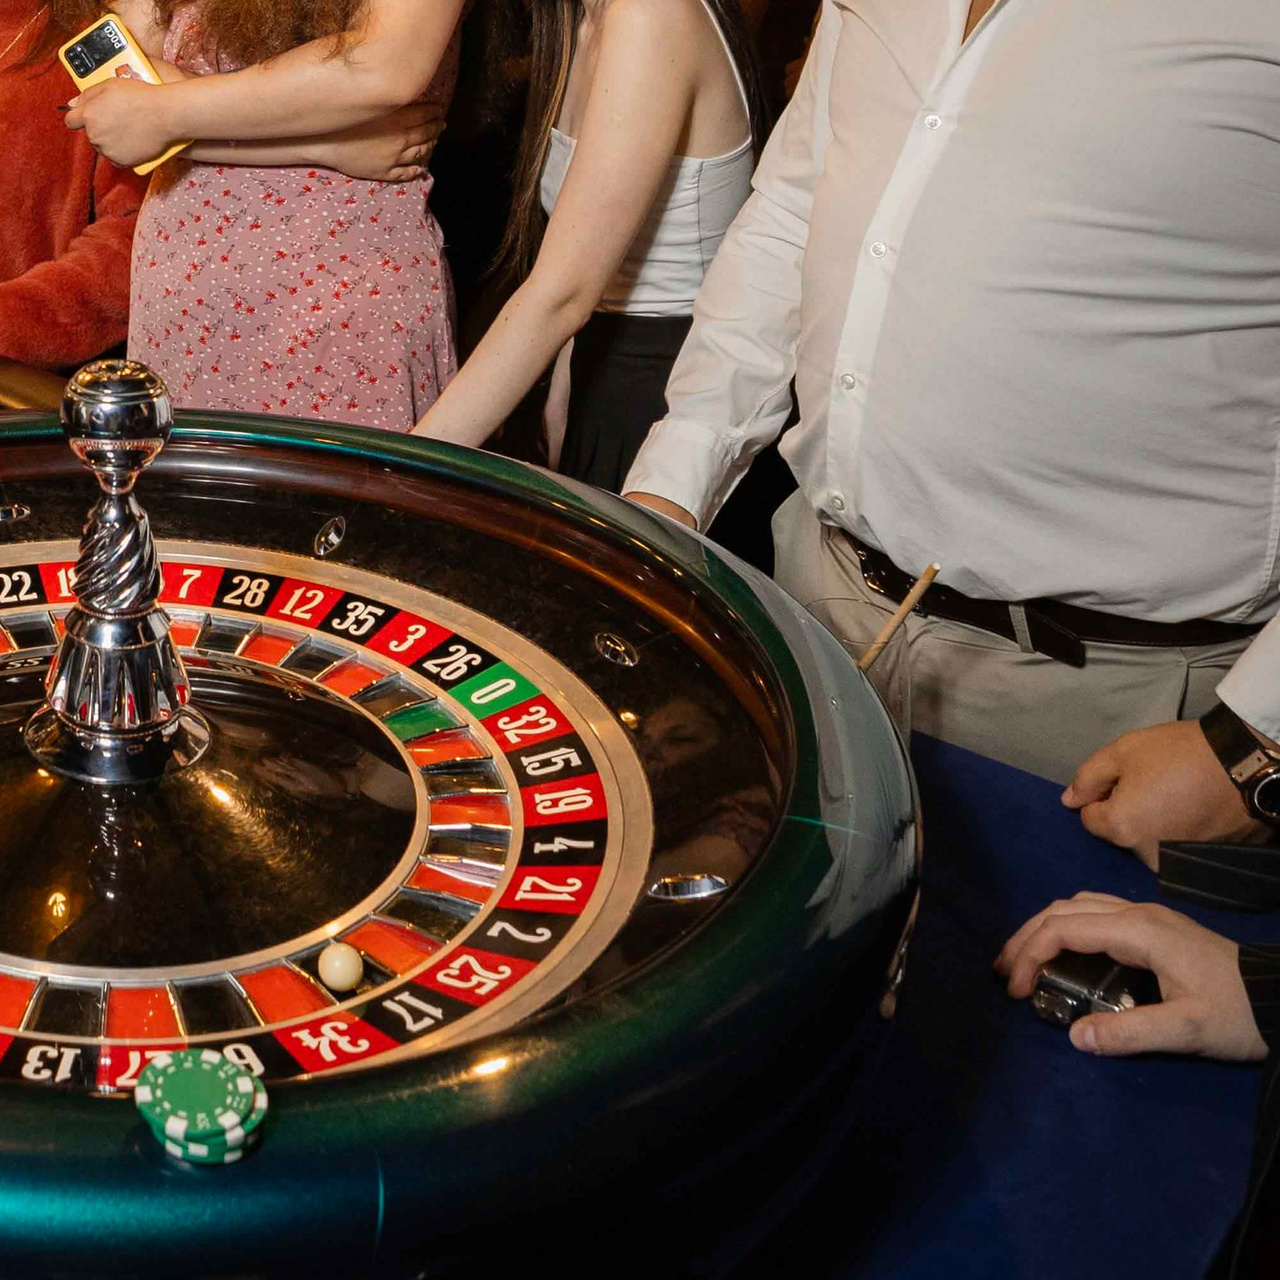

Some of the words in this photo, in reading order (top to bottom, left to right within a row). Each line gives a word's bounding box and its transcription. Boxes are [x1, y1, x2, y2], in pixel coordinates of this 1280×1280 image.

[104, 26, 123, 49] POCO
[179, 569, 201, 598] 7
[223, 576, 269, 606] 28
[280, 588, 324, 619] 12
[332, 602, 385, 635] 35
[389, 625, 426, 651] 3
[423, 640, 487, 680] 26
[471, 679, 516, 704] 0
[498, 707, 556, 743] 32
[521, 748, 581, 775] 15
[535, 788, 593, 814] 19
[534, 838, 593, 853] 4
[515, 877, 582, 900] 21
[487, 922, 551, 942] 2
[437, 948, 511, 994] 25
[383, 992, 442, 1031] 17
[292, 1022, 369, 1061] 34
[22, 1046, 81, 1082] 13
[223, 1043, 265, 1077] 6
